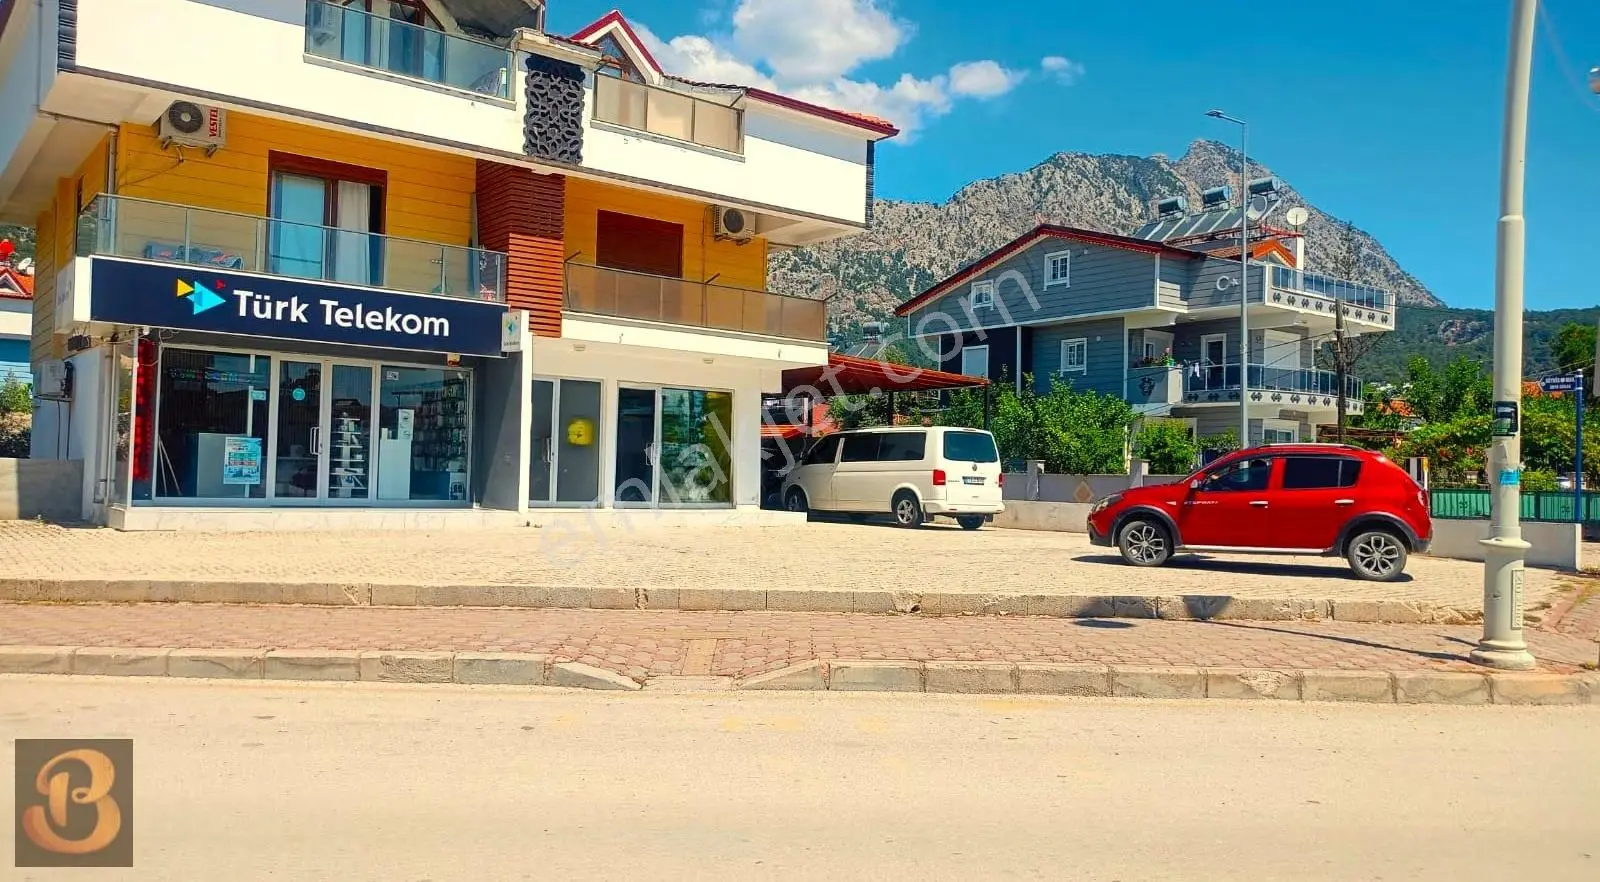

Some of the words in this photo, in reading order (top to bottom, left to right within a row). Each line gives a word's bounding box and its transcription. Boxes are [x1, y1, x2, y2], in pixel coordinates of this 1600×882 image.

[208, 105, 219, 138] VESTEL
[232, 289, 310, 323] Türk
[320, 299, 450, 337] Telekom
